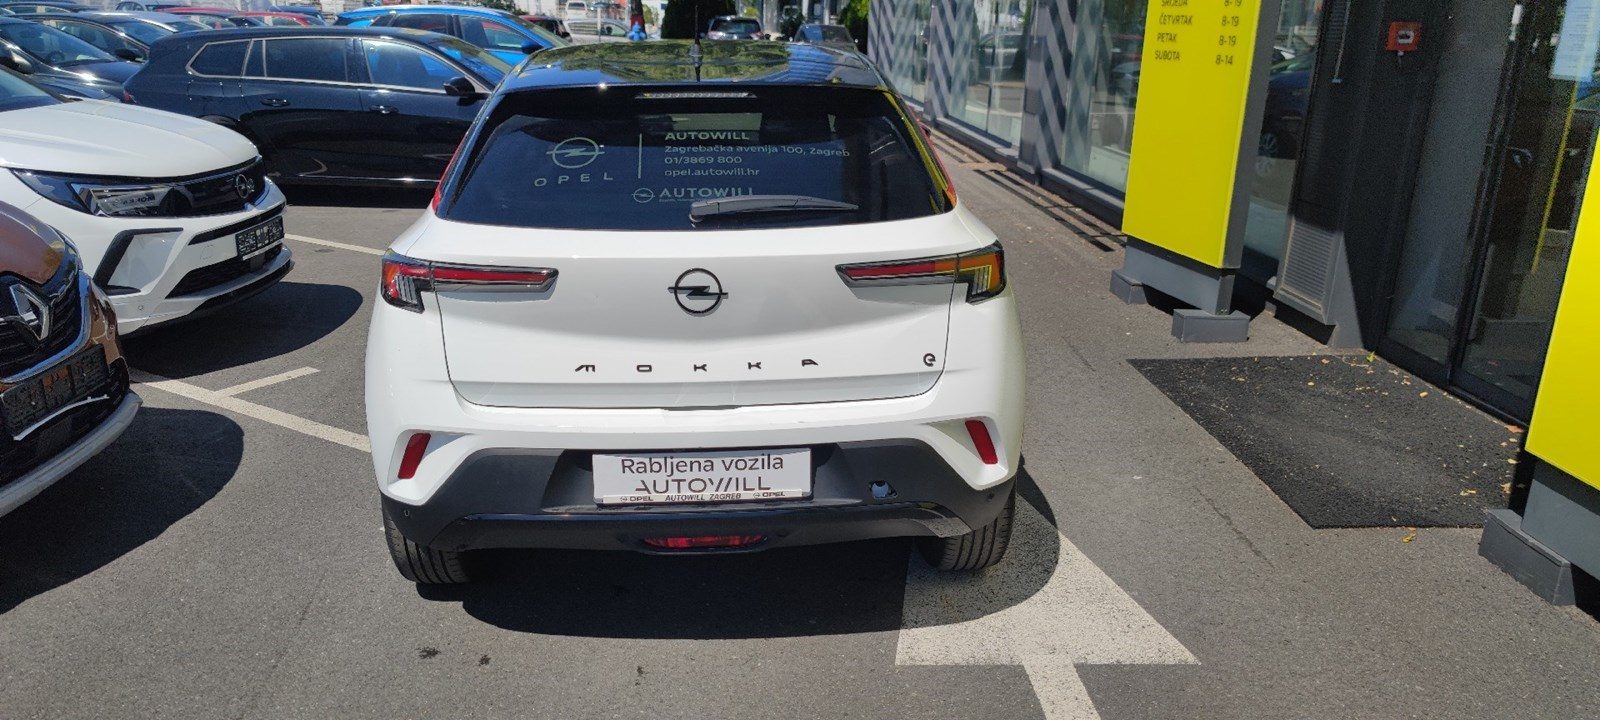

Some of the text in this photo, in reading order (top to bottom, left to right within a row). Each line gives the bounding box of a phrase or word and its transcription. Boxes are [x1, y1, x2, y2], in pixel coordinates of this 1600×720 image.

[1159, 13, 1239, 26] ČETVRTAK 8-19
[1157, 33, 1236, 46] PETAK 8-19
[1155, 51, 1233, 65] SUBOTA 8-14
[664, 131, 750, 140] AUTOWILL
[664, 144, 850, 157] Zagrebačka avenija 100, Zagreb
[664, 156, 742, 164] 01/3869 800
[664, 167, 760, 177] opel.autowill.hr
[534, 172, 614, 187] OPEL
[575, 358, 819, 373] MOKKA
[621, 453, 784, 477] Rabljena vozila
[635, 476, 771, 494] AUTOWILL
[665, 494, 705, 502] AUTOWILL
